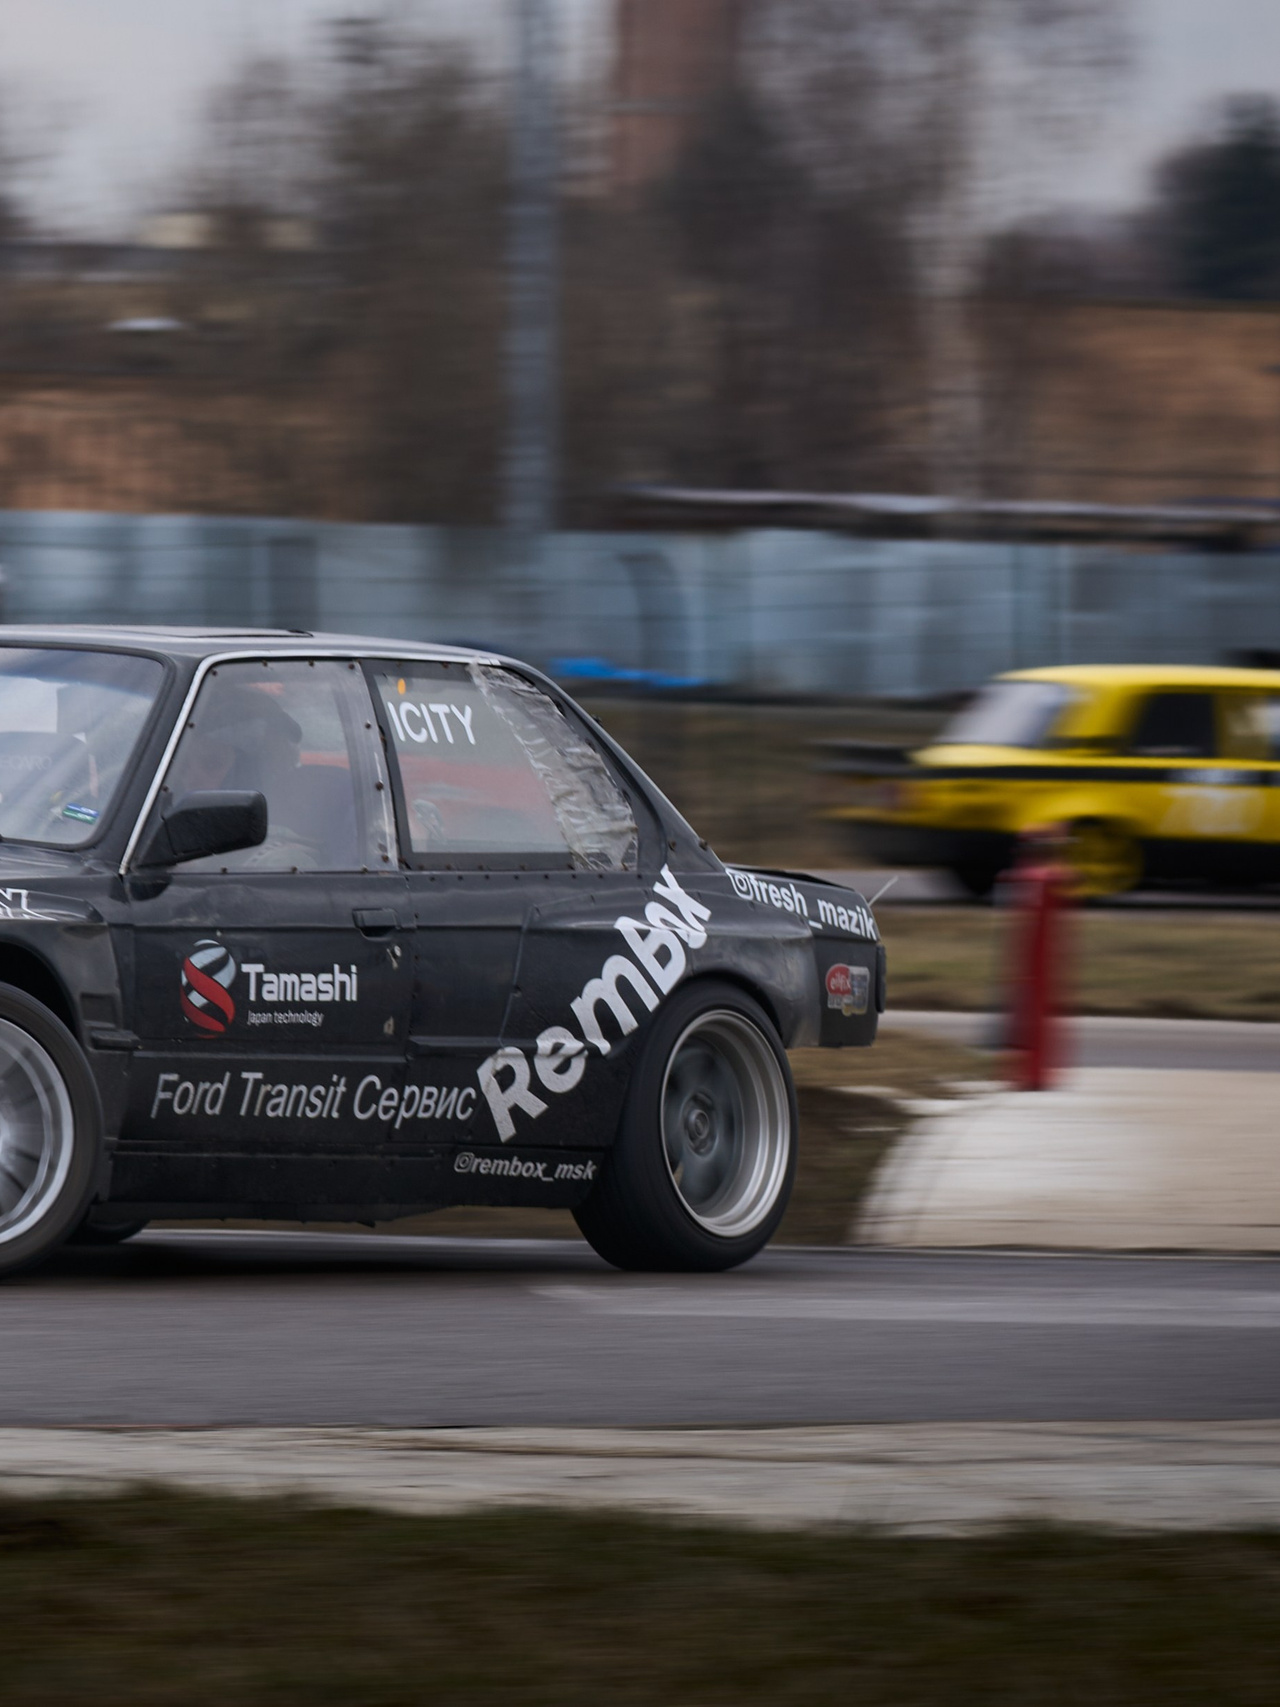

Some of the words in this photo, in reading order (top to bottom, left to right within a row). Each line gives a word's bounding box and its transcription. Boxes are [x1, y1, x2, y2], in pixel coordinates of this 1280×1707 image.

[240, 963, 358, 1001] Tamashi
[246, 1010, 273, 1026] Japan
[274, 1010, 324, 1027] technology
[150, 1071, 231, 1119] Ford
[238, 1071, 347, 1119] Transit
[352, 1074, 476, 1130] Сервис
